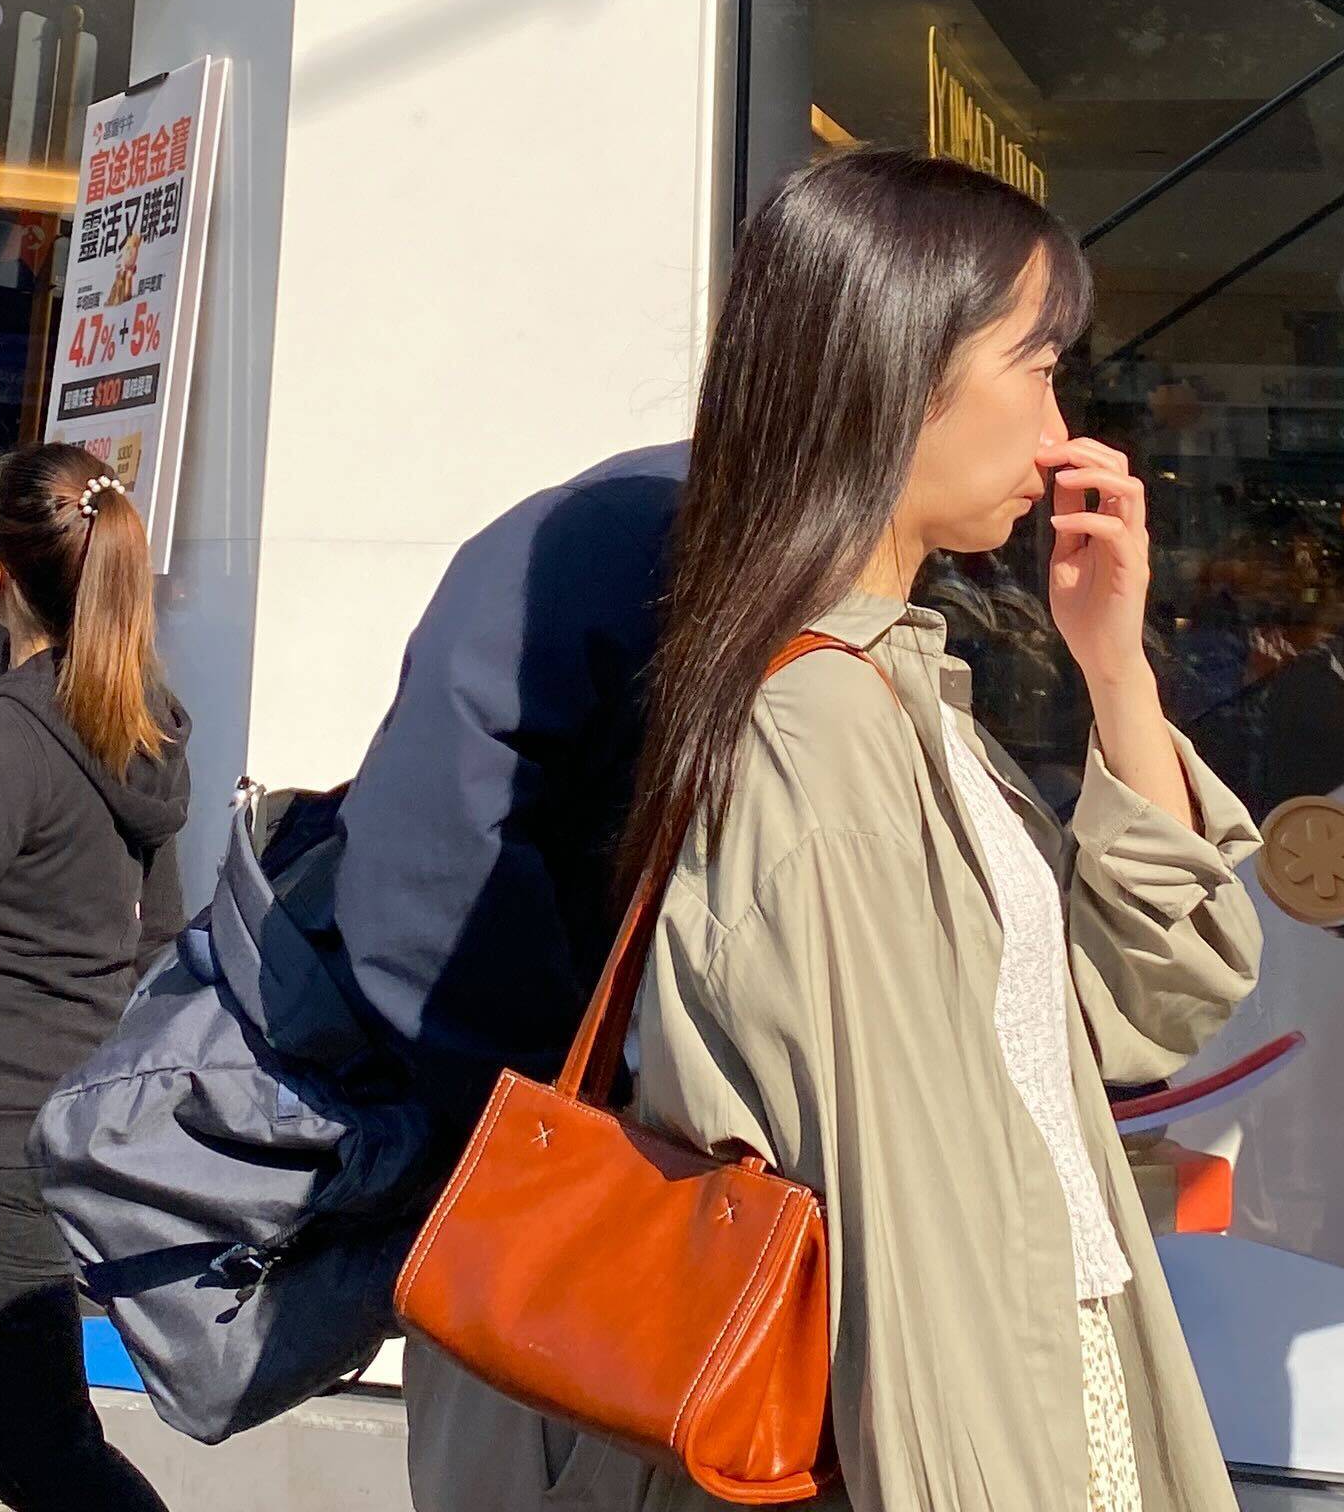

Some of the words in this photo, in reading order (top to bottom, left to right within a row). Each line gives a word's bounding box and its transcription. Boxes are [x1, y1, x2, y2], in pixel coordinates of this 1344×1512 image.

[85, 116, 192, 205] 富途現金寶
[67, 311, 116, 368] 4.7%
[129, 301, 161, 357] 5%
